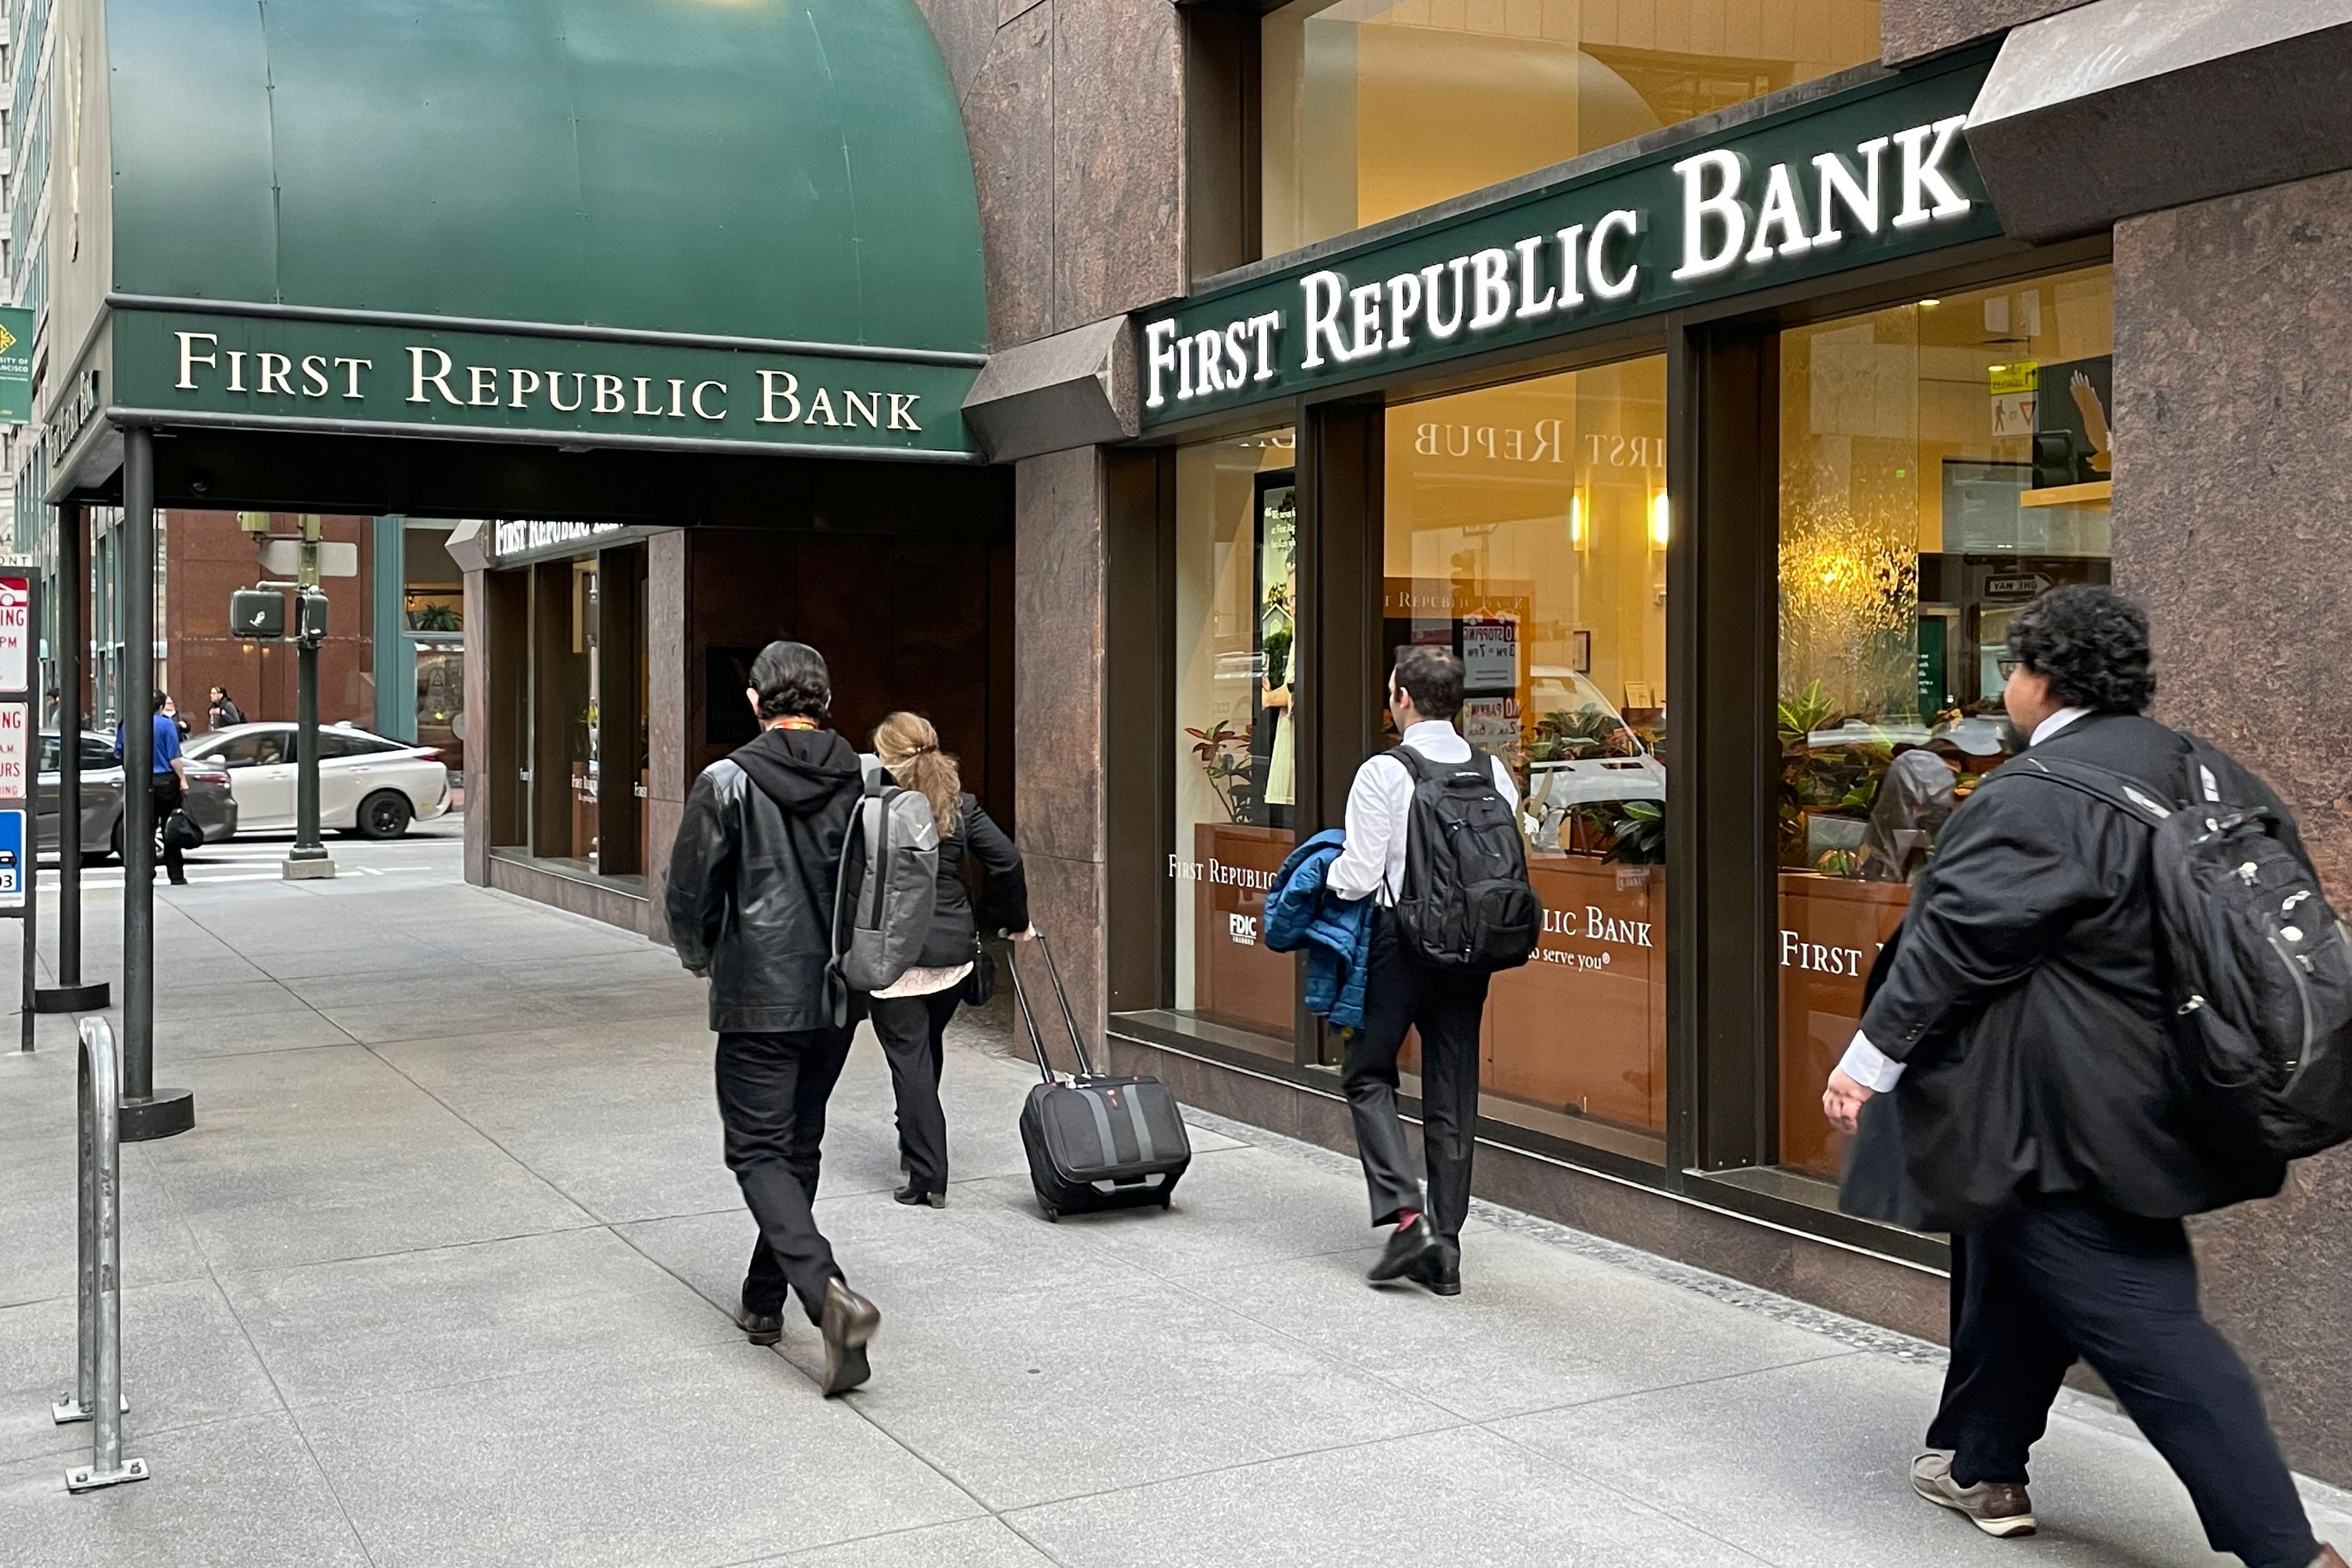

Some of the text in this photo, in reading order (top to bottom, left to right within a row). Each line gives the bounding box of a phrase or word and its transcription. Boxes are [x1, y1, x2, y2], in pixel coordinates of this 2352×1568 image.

[1145, 114, 1971, 408] FIRST REPUBLIC BANK
[0, 364, 28, 372] NCISCO
[174, 331, 922, 431] FIRST REPUBLIC BANK
[1, 609, 24, 626] ING
[0, 786, 18, 795] ING
[1169, 854, 1204, 881] FIRST
[1230, 913, 1257, 937] FDIC
[1585, 906, 1653, 948] BANK
[1543, 949, 1575, 966] serve
[1780, 930, 1863, 977] FIRST
